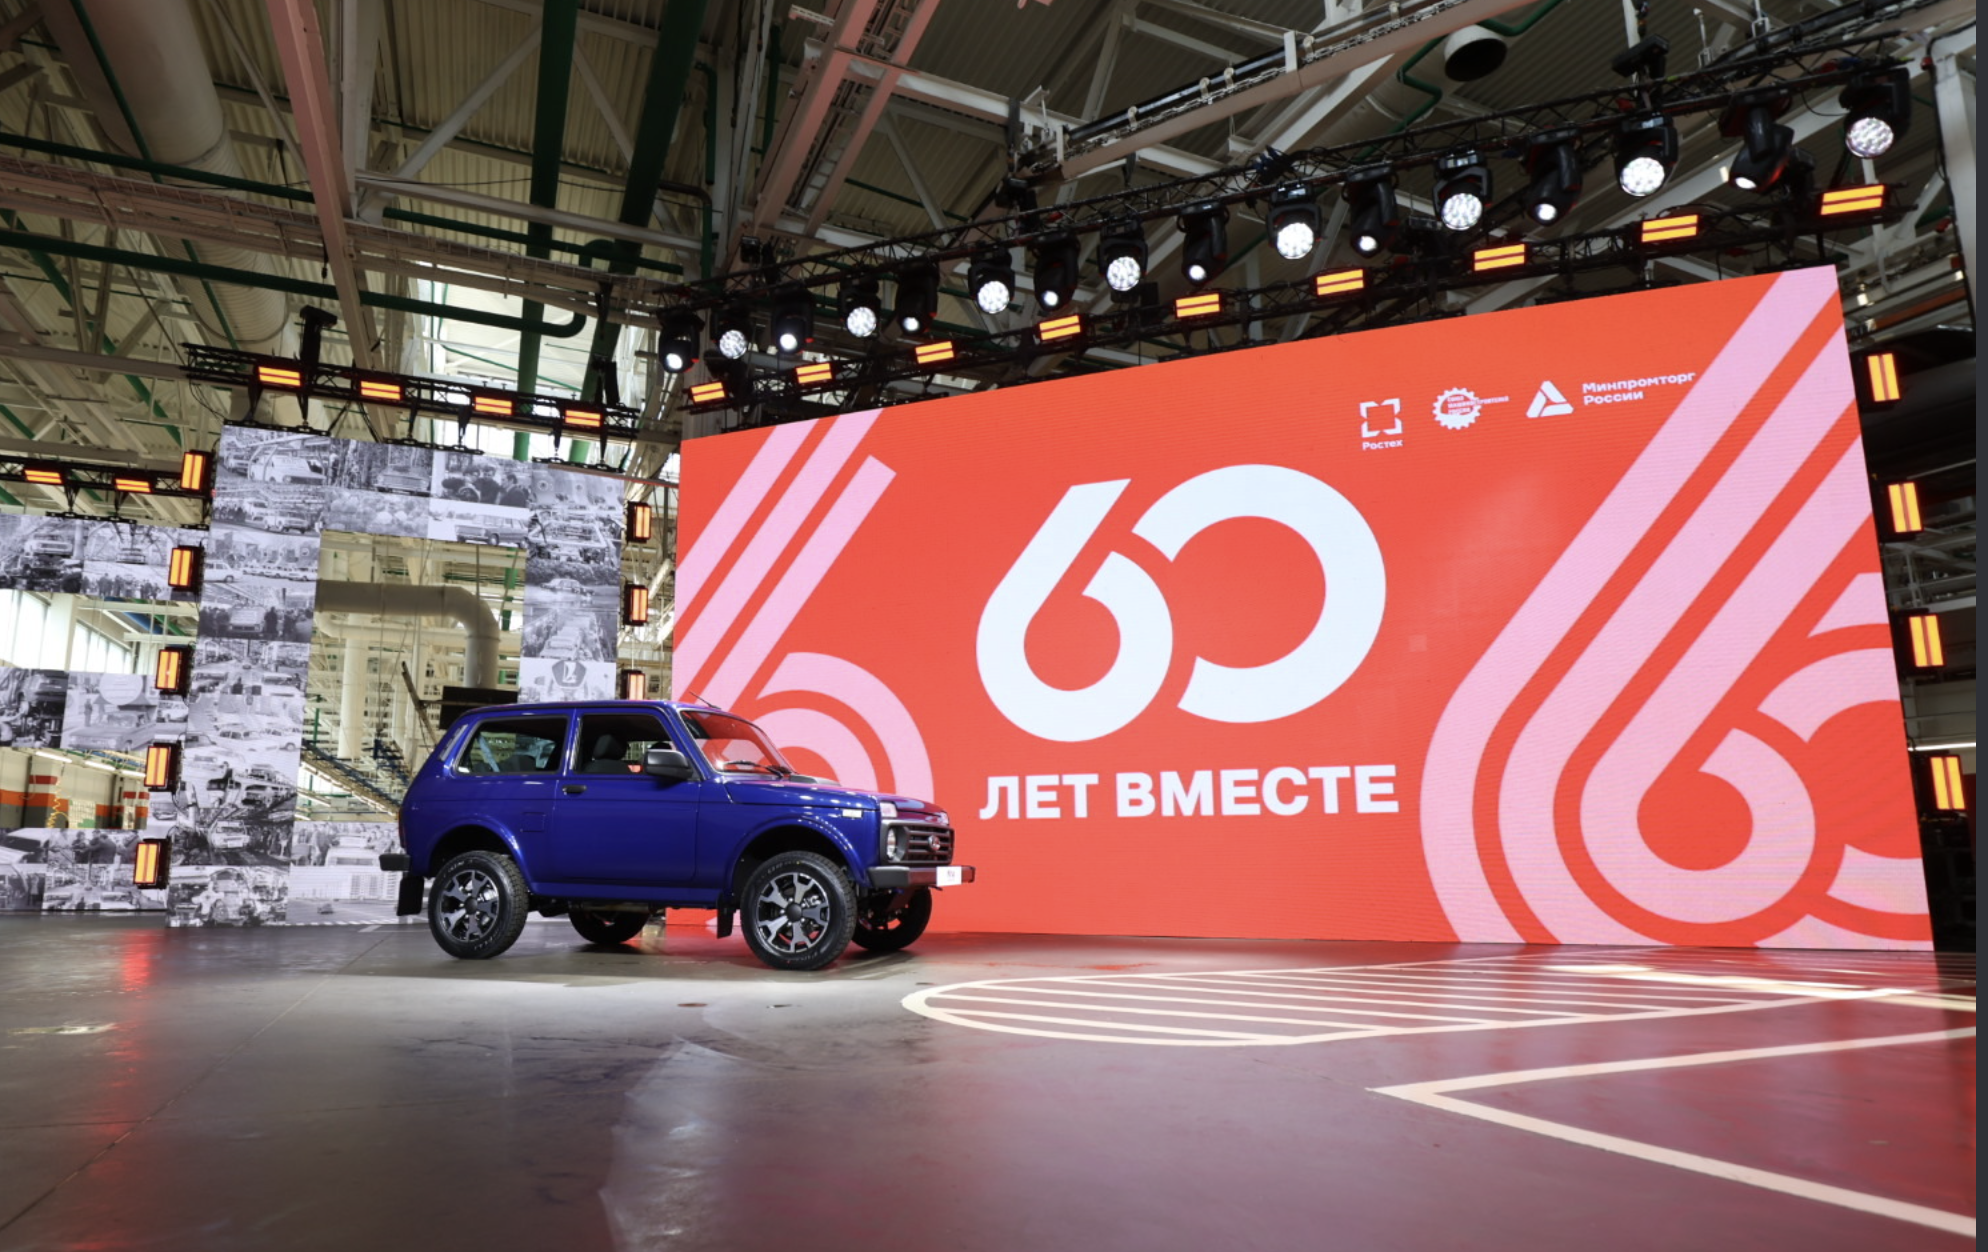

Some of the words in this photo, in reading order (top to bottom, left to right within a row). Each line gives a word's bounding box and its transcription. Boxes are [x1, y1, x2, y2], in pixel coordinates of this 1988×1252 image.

[1583, 373, 1696, 392] Минпромторг
[1583, 391, 1645, 405] России
[1361, 438, 1404, 451] Ростех
[976, 463, 1387, 742] 60
[980, 774, 1098, 820] ЛЕТ
[1116, 764, 1400, 818] ВМЕСТЕ
